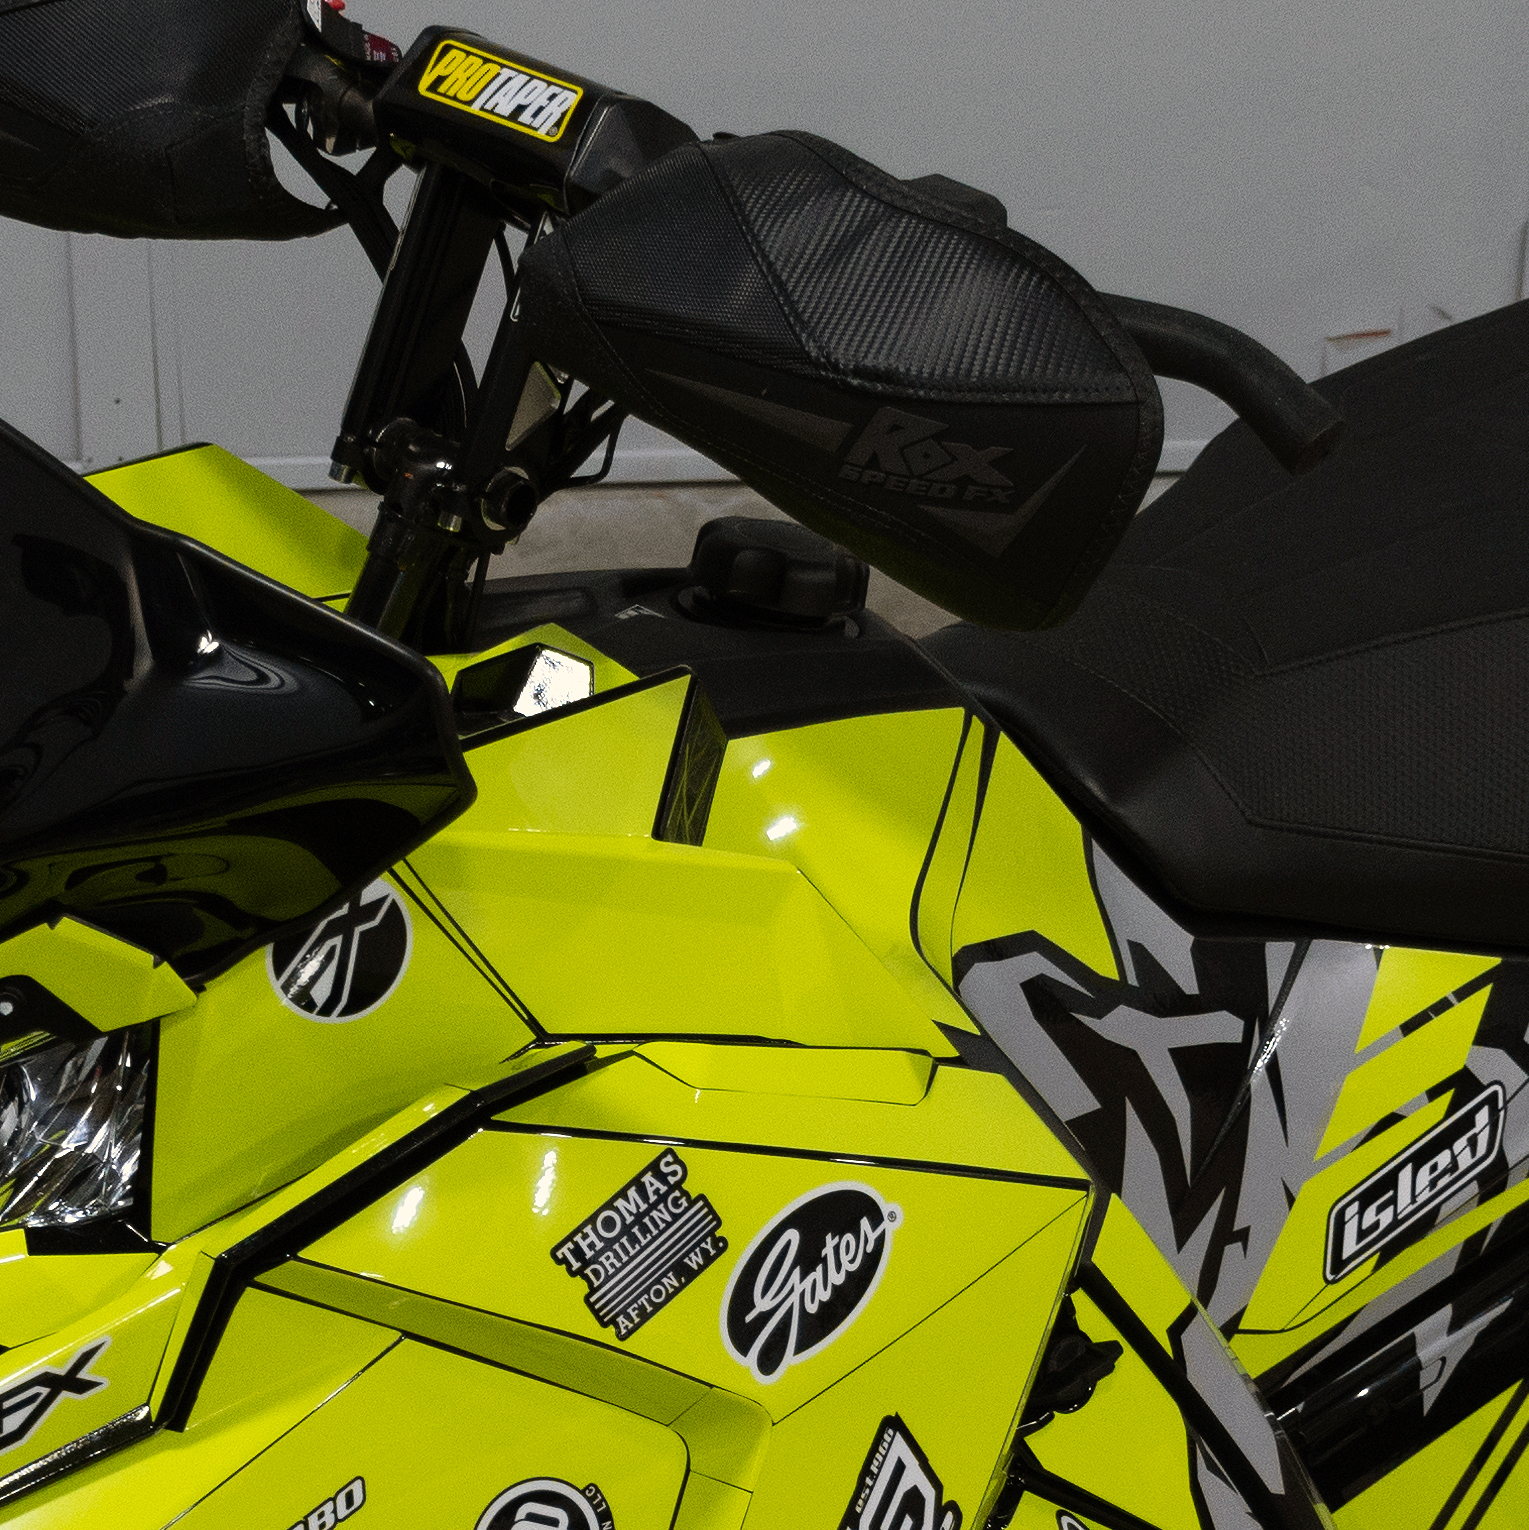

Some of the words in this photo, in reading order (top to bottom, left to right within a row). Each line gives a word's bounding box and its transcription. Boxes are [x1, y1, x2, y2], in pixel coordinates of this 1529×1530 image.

[837, 464, 957, 500] SPEED
[556, 1153, 683, 1272] THOMAS
[584, 1190, 688, 1288] DRILLING
[616, 1271, 686, 1335] AFTON,
[683, 1236, 724, 1271] WY.
[744, 1221, 892, 1373] Gates
[585, 1485, 607, 1513] LLC
